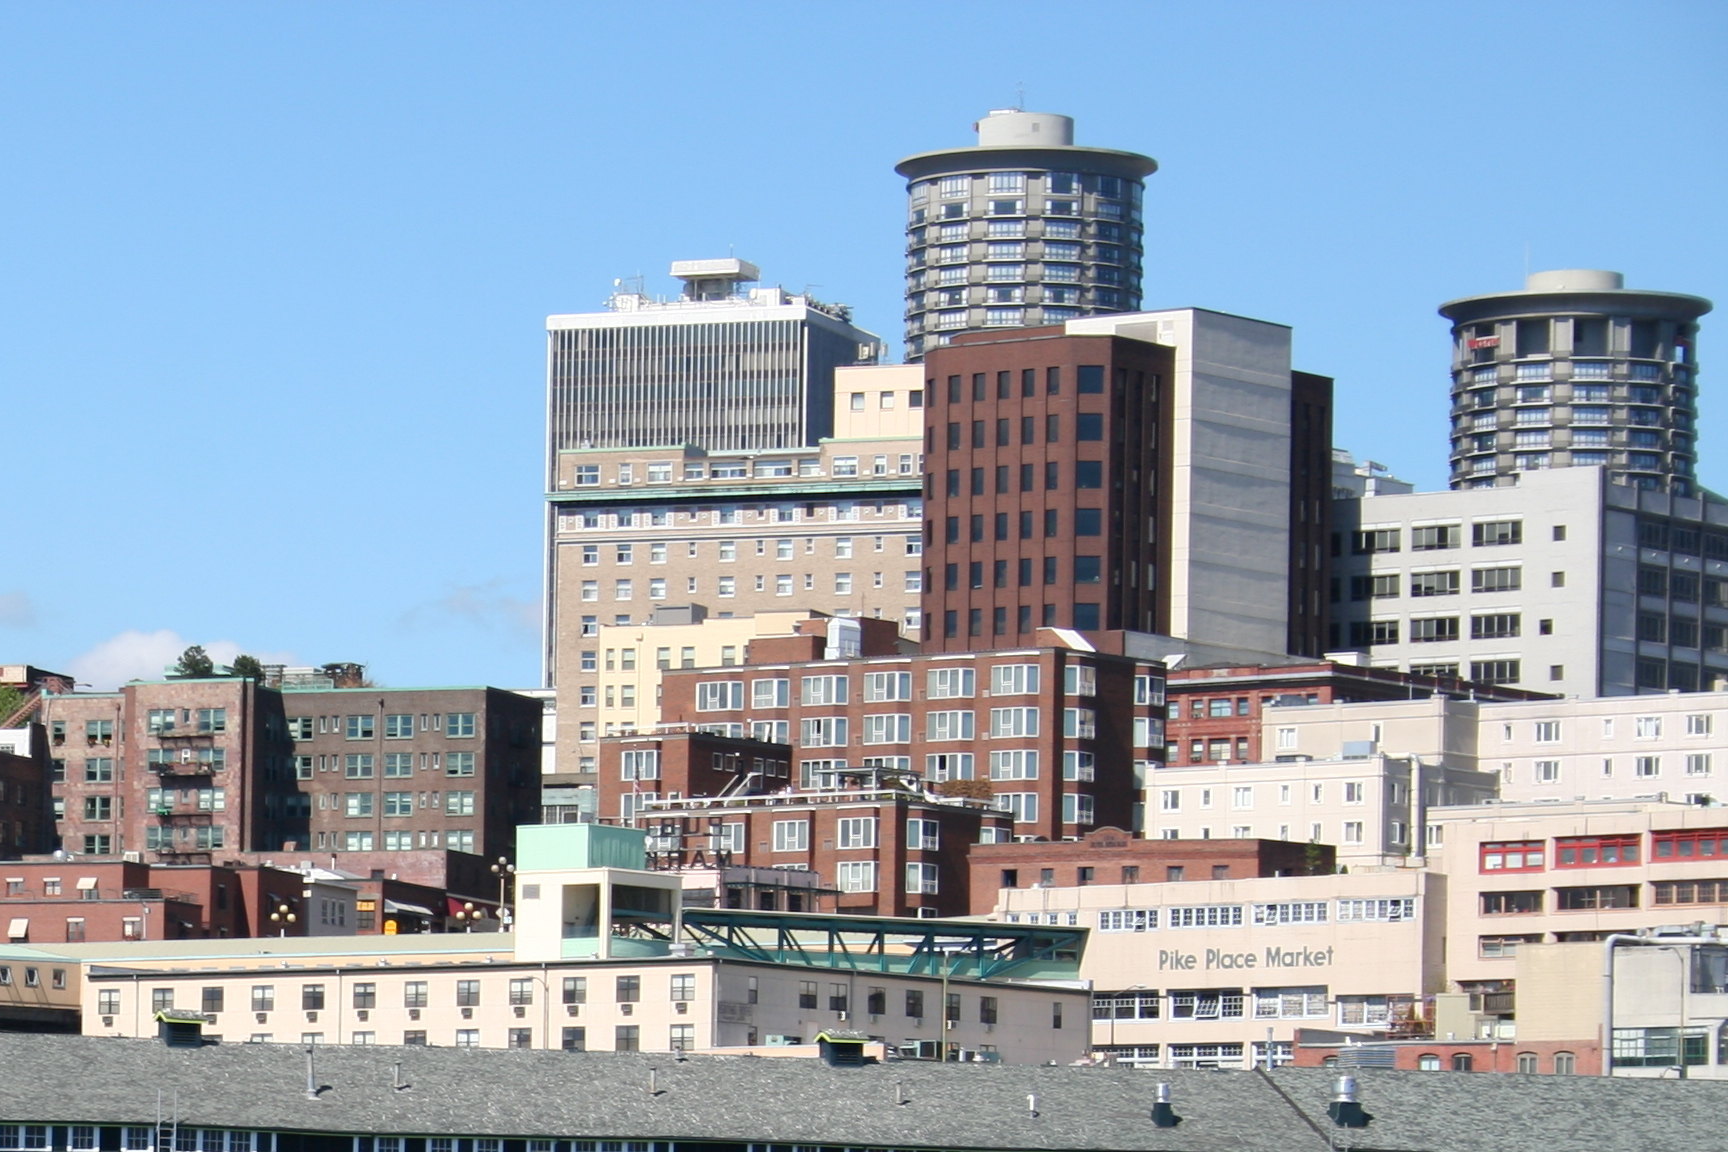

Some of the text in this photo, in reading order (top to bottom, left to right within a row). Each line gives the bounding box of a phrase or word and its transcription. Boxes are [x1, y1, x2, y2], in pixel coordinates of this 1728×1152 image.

[1159, 945, 1334, 970] Pike Place Market
